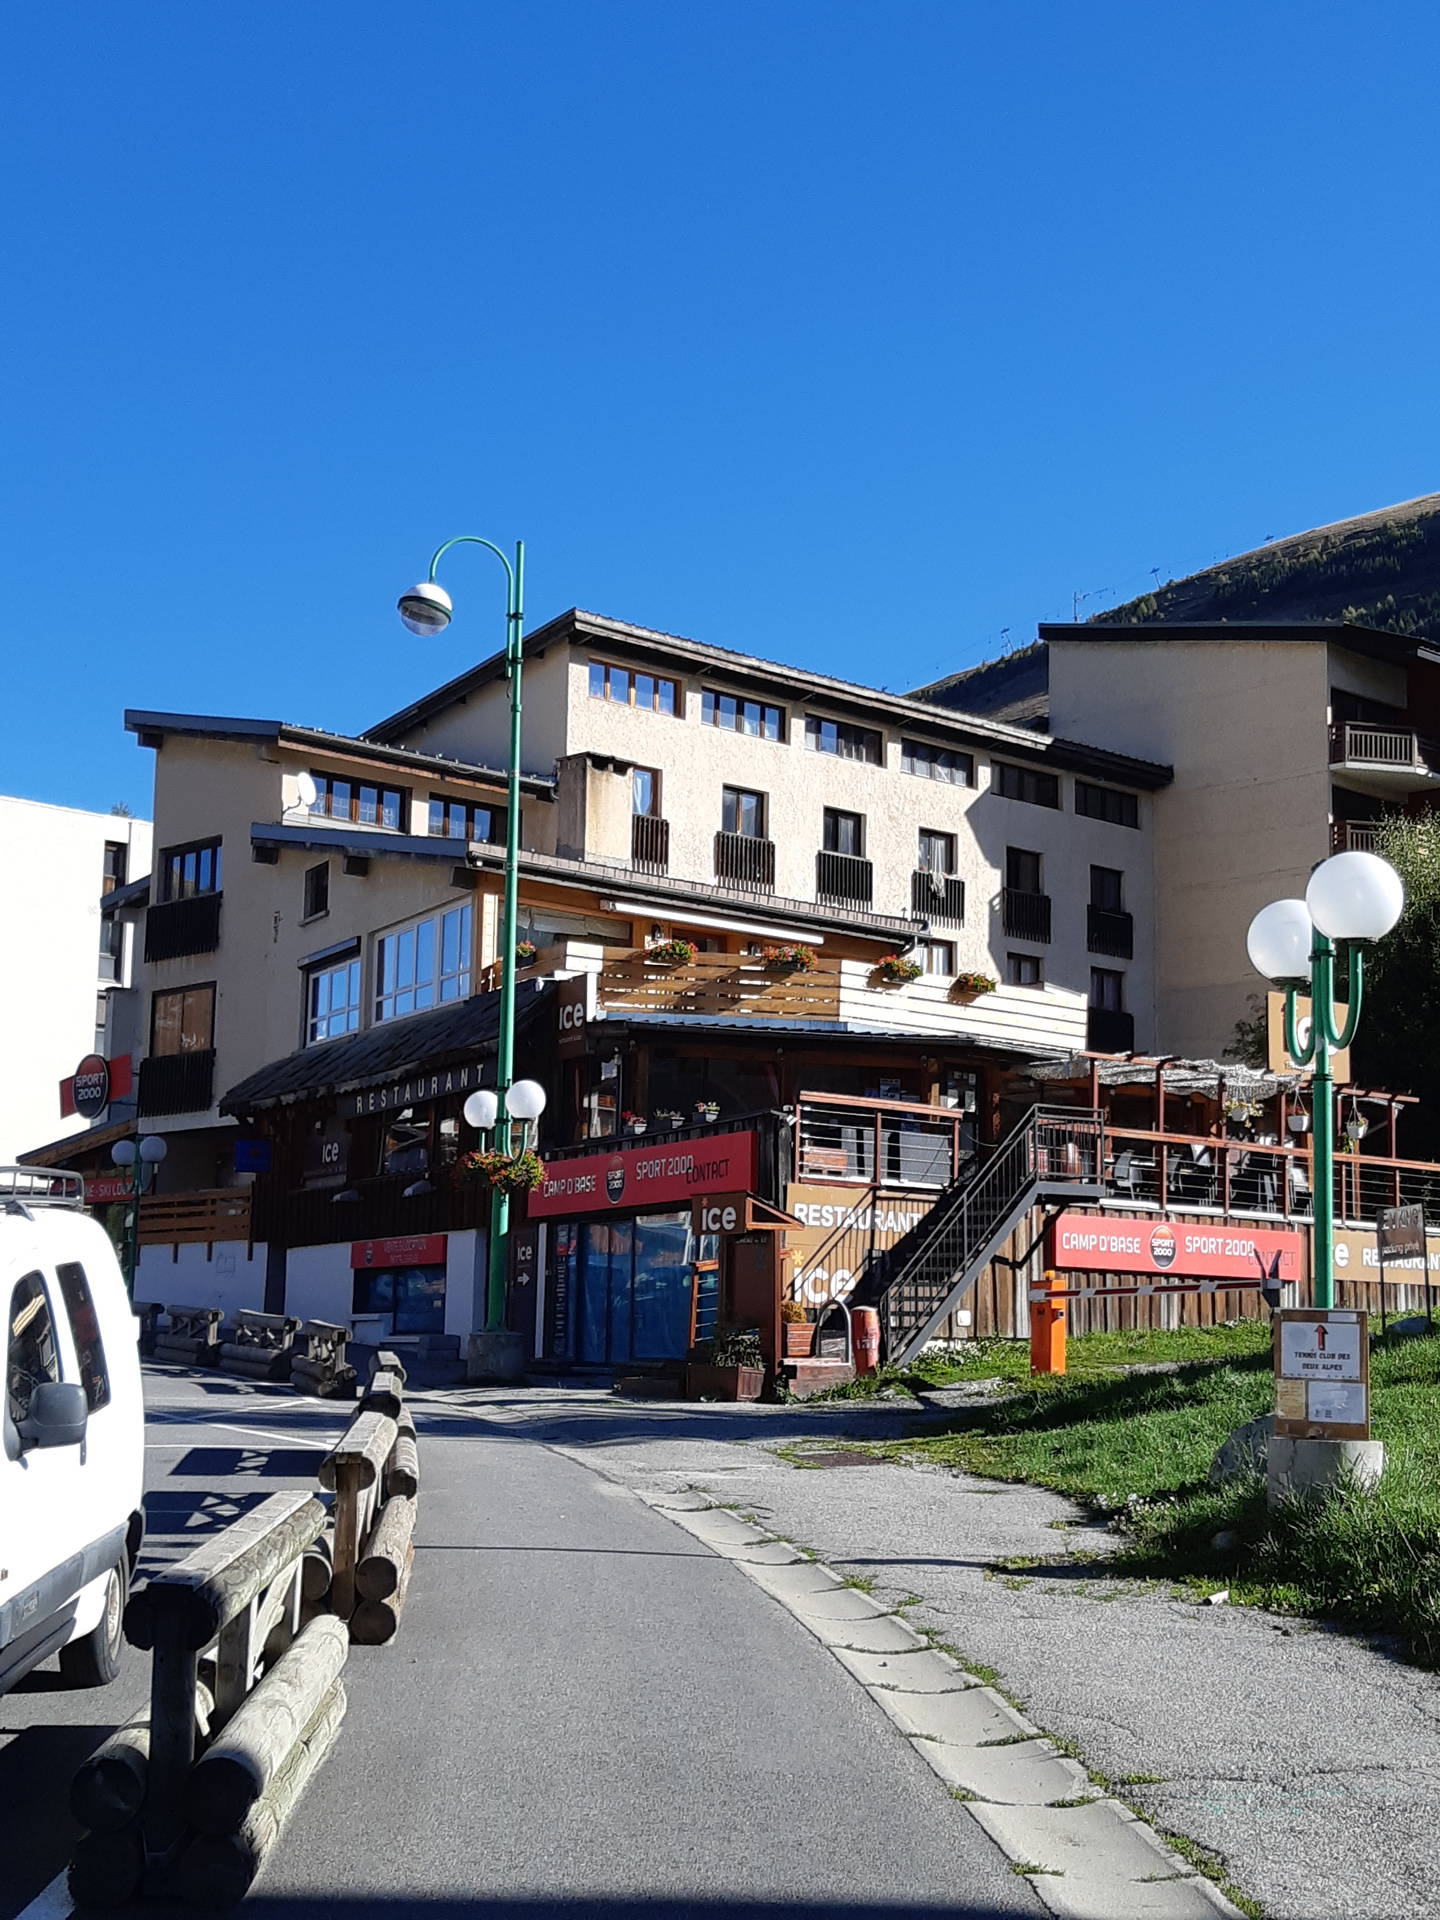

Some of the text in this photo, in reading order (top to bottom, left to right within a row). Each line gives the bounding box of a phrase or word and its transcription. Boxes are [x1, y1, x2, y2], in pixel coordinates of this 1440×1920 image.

[76, 1072, 105, 1087] SPORT
[356, 1064, 484, 1114] RESTAURANT
[78, 1087, 102, 1100] 2000
[607, 1169, 624, 1180] SPORT
[636, 1155, 693, 1180] SPORT 2000
[686, 1159, 729, 1185] CONTACT
[543, 1179, 566, 1198] CAMP
[608, 1180, 623, 1190] 2000
[702, 1198, 737, 1231] ice
[794, 1203, 922, 1234] RESTAURANT
[1062, 1232, 1141, 1254] CAMP D'BASE
[1151, 1238, 1175, 1248] SPORT
[1153, 1247, 1173, 1257] 2000
[1185, 1236, 1255, 1257] SPORT 2000
[793, 1266, 857, 1303] ice
[1294, 1351, 1351, 1360] TENNIS CLUB DES
[1302, 1362, 1343, 1371] DEUX ALPES
